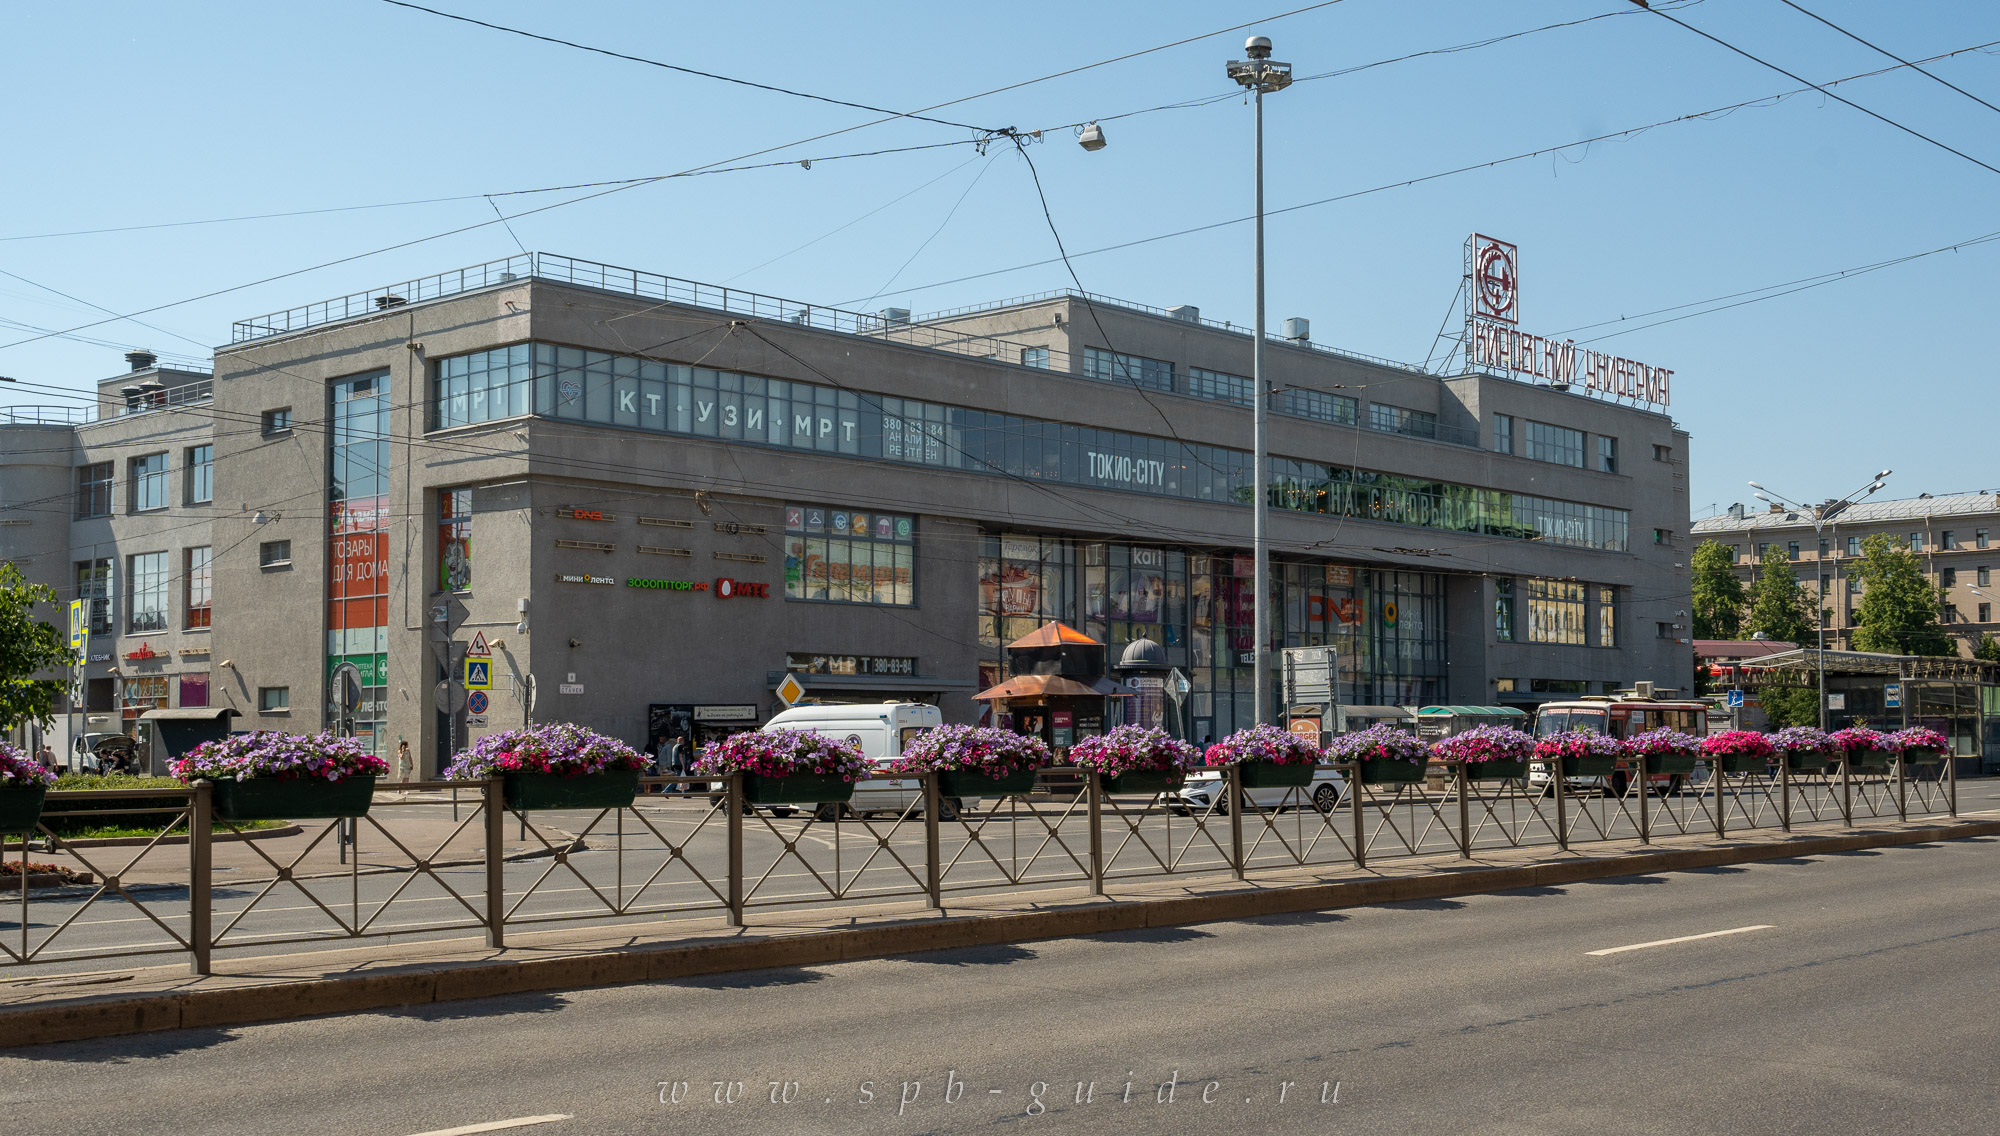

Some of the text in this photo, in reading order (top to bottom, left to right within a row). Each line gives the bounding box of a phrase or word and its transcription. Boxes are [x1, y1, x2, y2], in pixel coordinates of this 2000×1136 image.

[1474, 320, 1674, 406] КИРОВСКИЙ УНИВЕРМАГ
[452, 382, 505, 413] МРТ
[620, 390, 855, 442] КТ УЗИ МРТ
[889, 431, 939, 447] АНАЛИЗЫ
[889, 445, 937, 460] РЕНТГЕН
[574, 510, 603, 521] DNS
[1371, 488, 1477, 530] САМОВЫВОЗ
[333, 539, 372, 558] ТОВАРЫ
[1004, 541, 1038, 553] Теремок
[1133, 547, 1162, 566] kari
[333, 560, 388, 583] ДЛЯ ДОМА
[591, 576, 614, 585] лента
[806, 554, 909, 589] Галамарт
[737, 582, 770, 599] МТС
[1309, 595, 1365, 624] DNS
[1399, 621, 1423, 631] лента
[829, 656, 912, 674] МРТ 380-83-84
[1240, 653, 1255, 664] TELE
